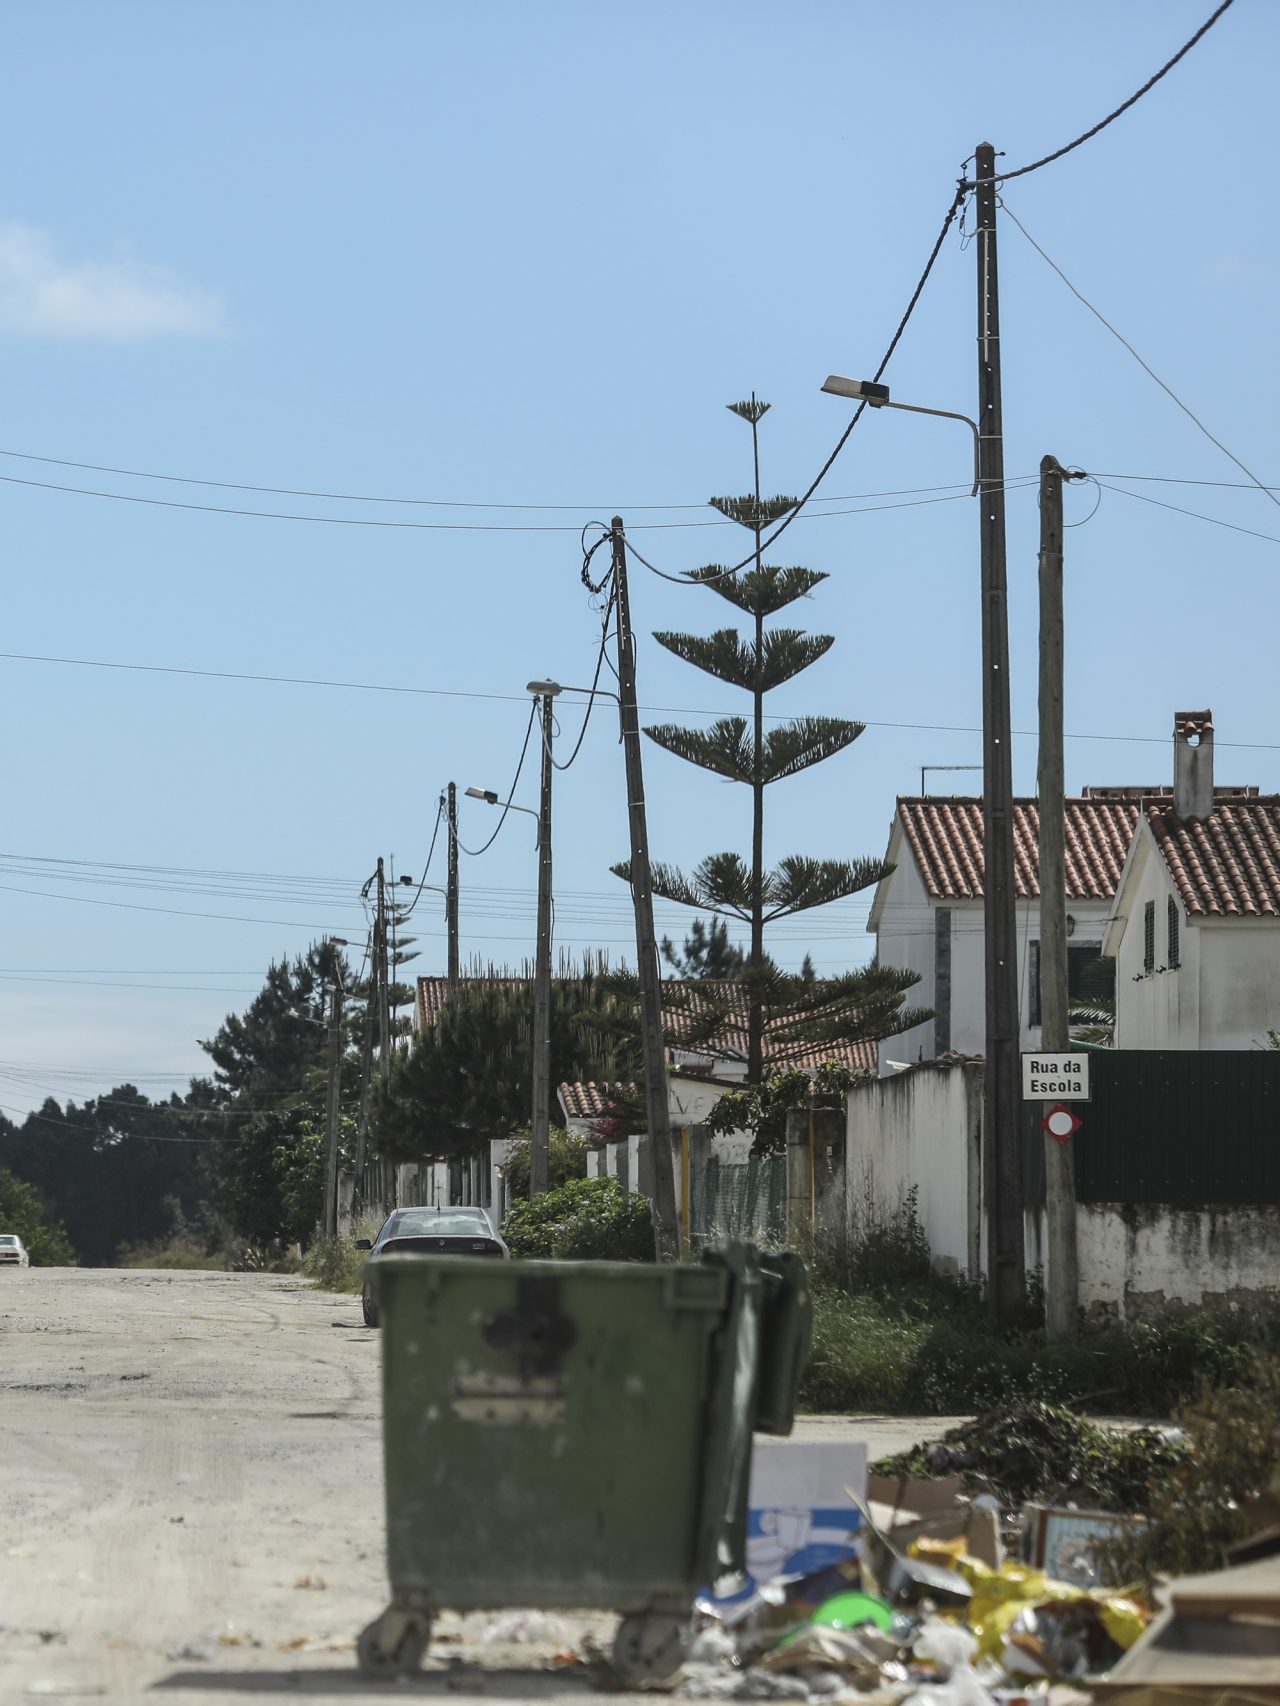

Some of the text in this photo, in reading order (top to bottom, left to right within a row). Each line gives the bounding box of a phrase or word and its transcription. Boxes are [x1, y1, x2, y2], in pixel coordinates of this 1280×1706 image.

[1030, 1060, 1081, 1074] Rua da
[1030, 1079, 1082, 1093] Escola
